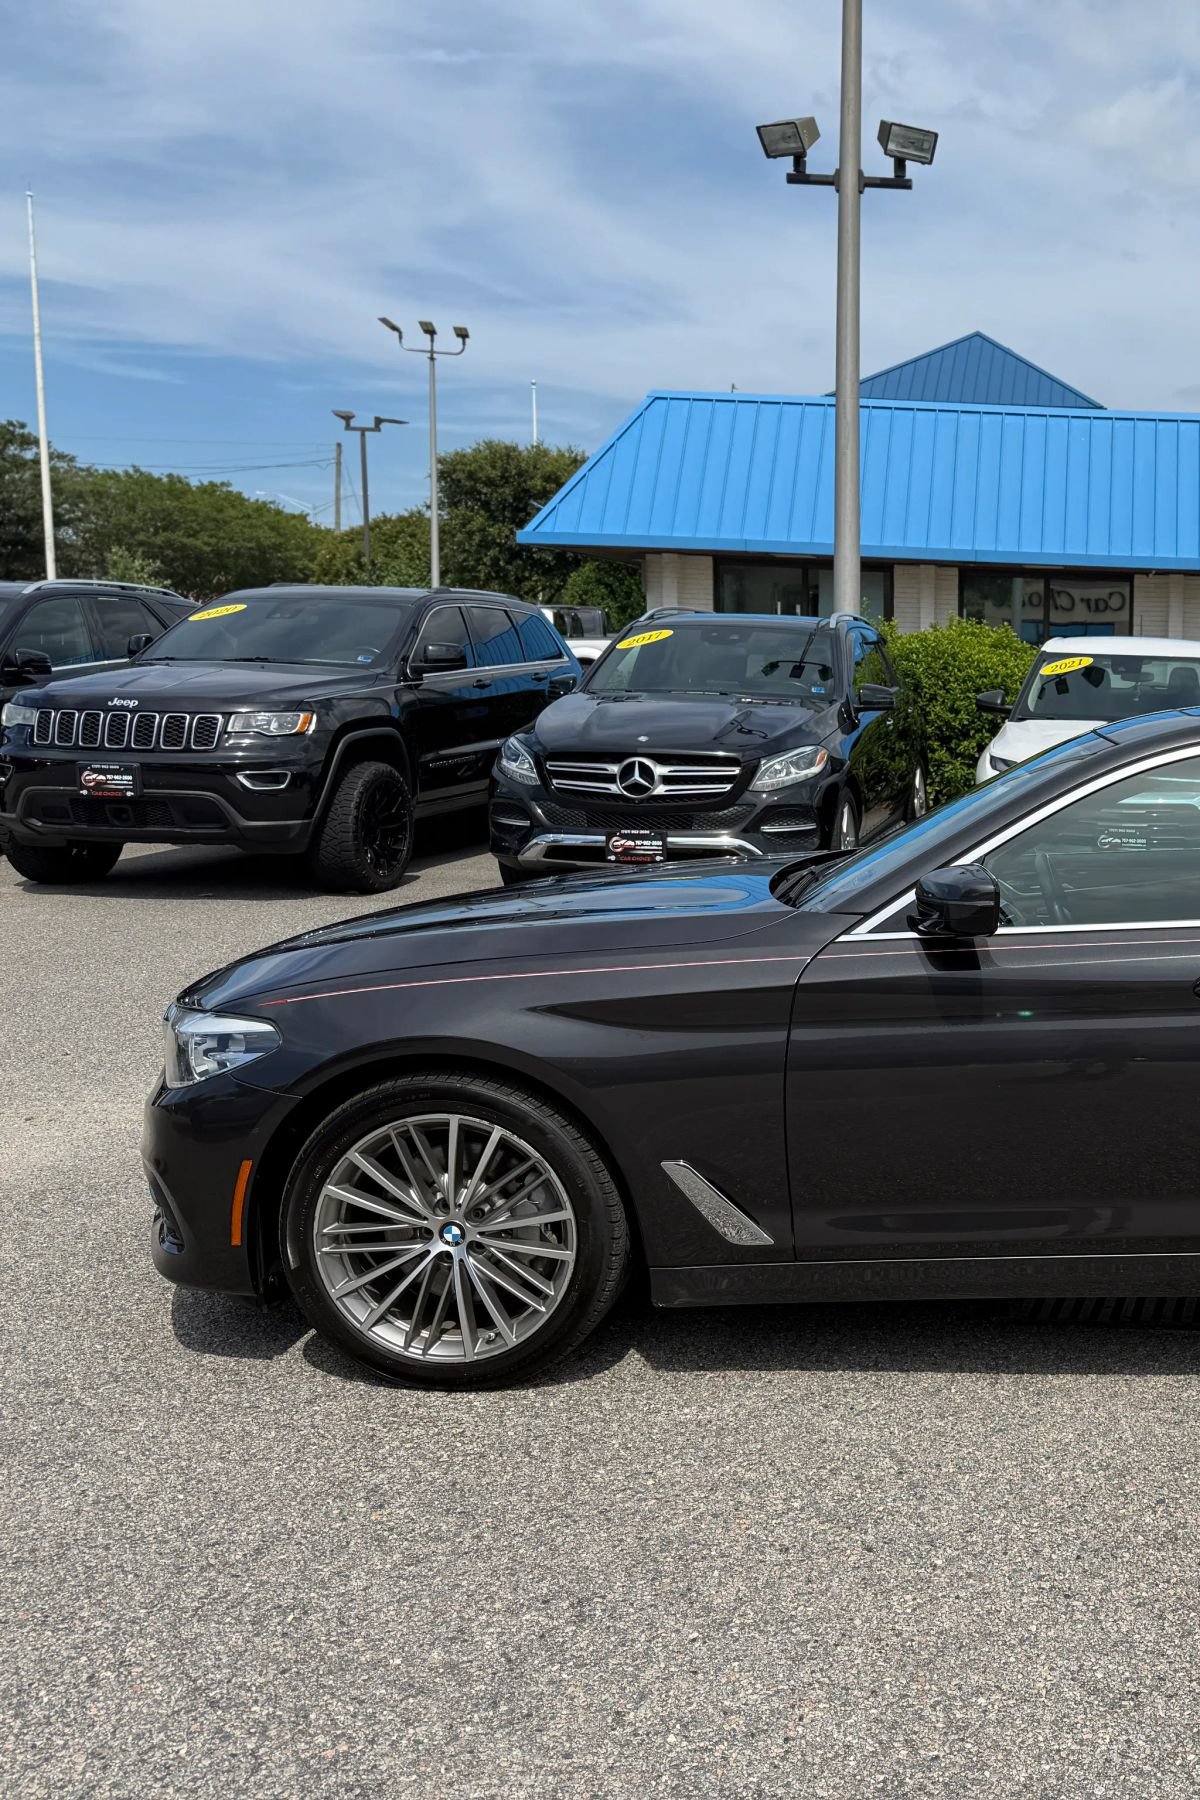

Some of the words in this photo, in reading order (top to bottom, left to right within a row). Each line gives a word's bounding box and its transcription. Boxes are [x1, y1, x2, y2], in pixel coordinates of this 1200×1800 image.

[627, 631, 663, 646] 2017
[1050, 658, 1083, 672] 2021
[107, 697, 139, 709] Jeep
